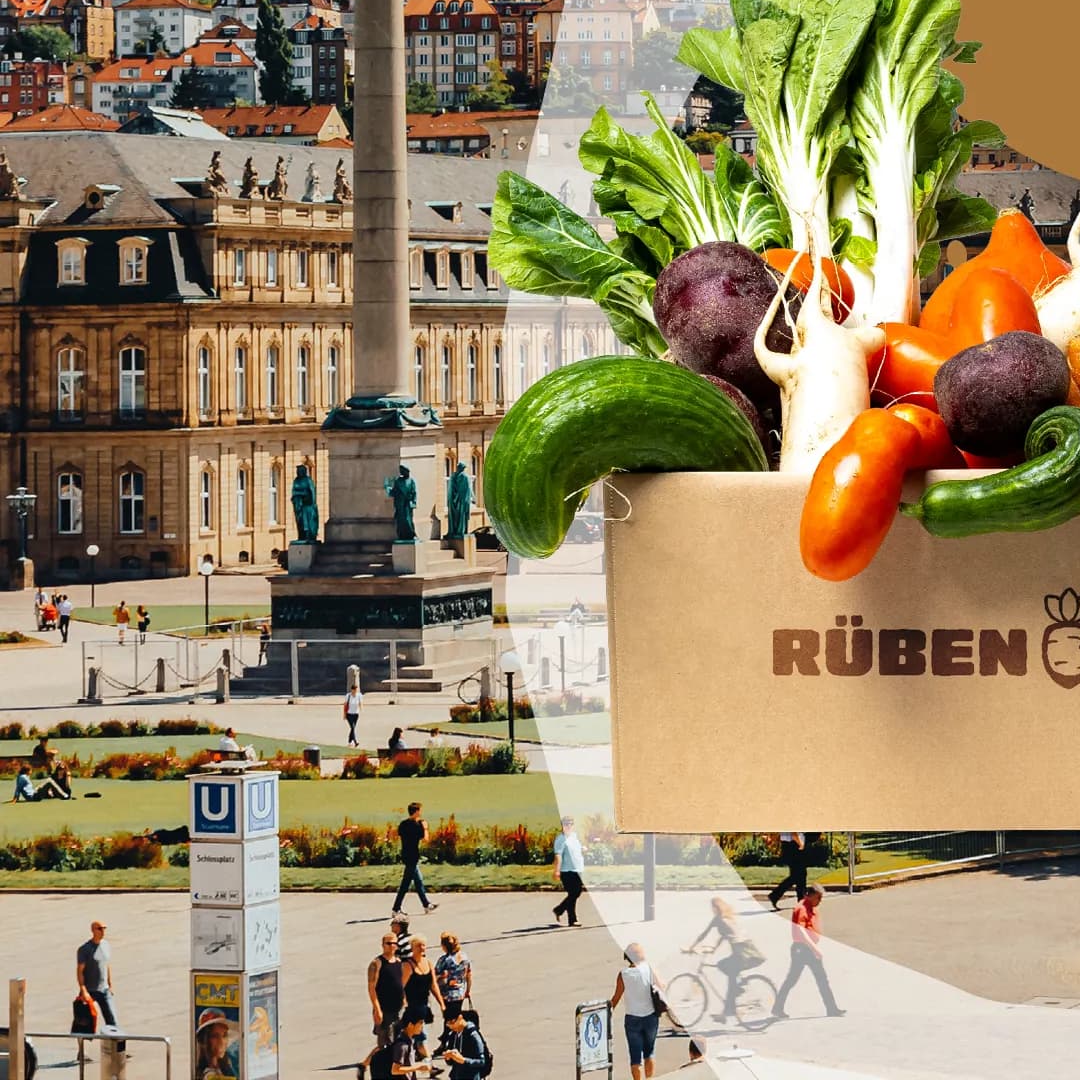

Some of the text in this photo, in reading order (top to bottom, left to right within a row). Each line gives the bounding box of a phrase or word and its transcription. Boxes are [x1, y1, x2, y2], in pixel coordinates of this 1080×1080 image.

[772, 615, 1028, 677] RÜBEN
[201, 786, 229, 821] U
[251, 782, 272, 819] U
[196, 983, 240, 1001] CMT
